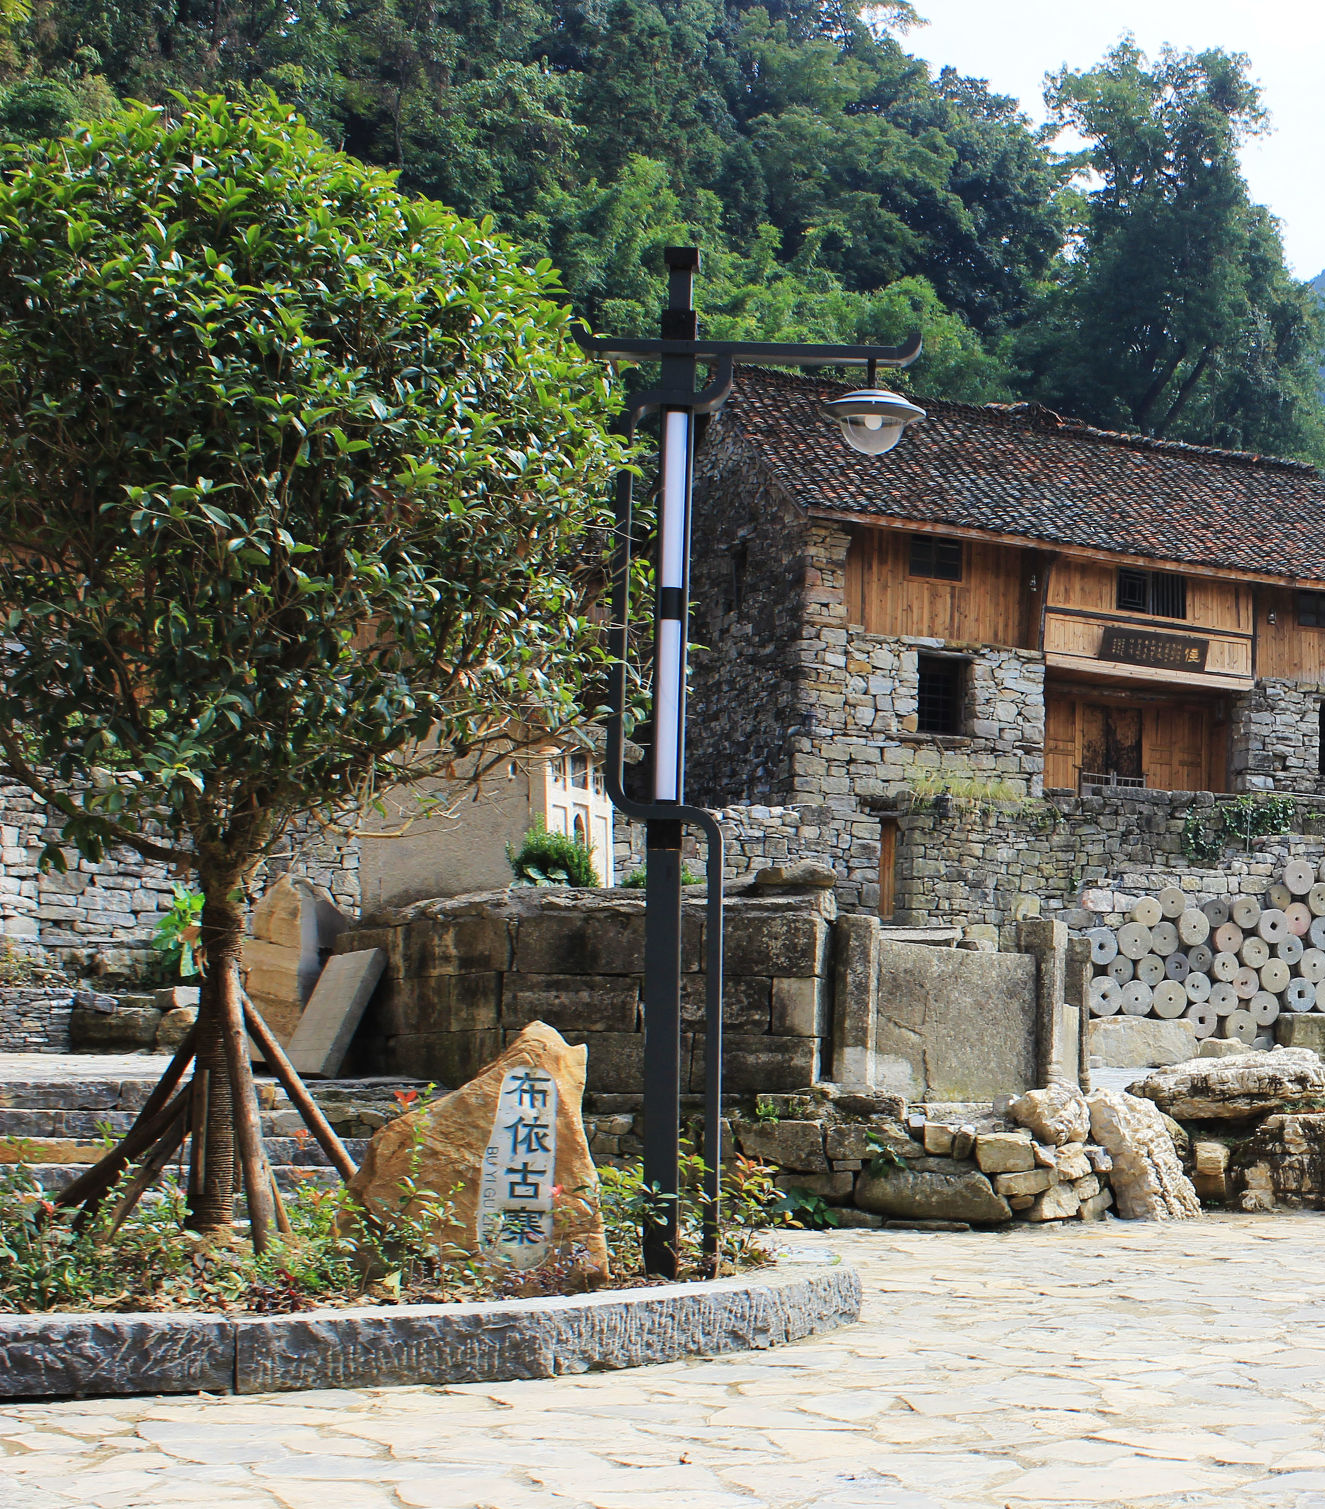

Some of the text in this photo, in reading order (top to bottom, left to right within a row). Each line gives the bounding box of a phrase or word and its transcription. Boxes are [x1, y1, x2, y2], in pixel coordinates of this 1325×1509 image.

[486, 1146, 499, 1166] BU
[504, 1072, 551, 1245] 布依古寨
[484, 1170, 497, 1182] YI
[483, 1187, 496, 1209] GU
